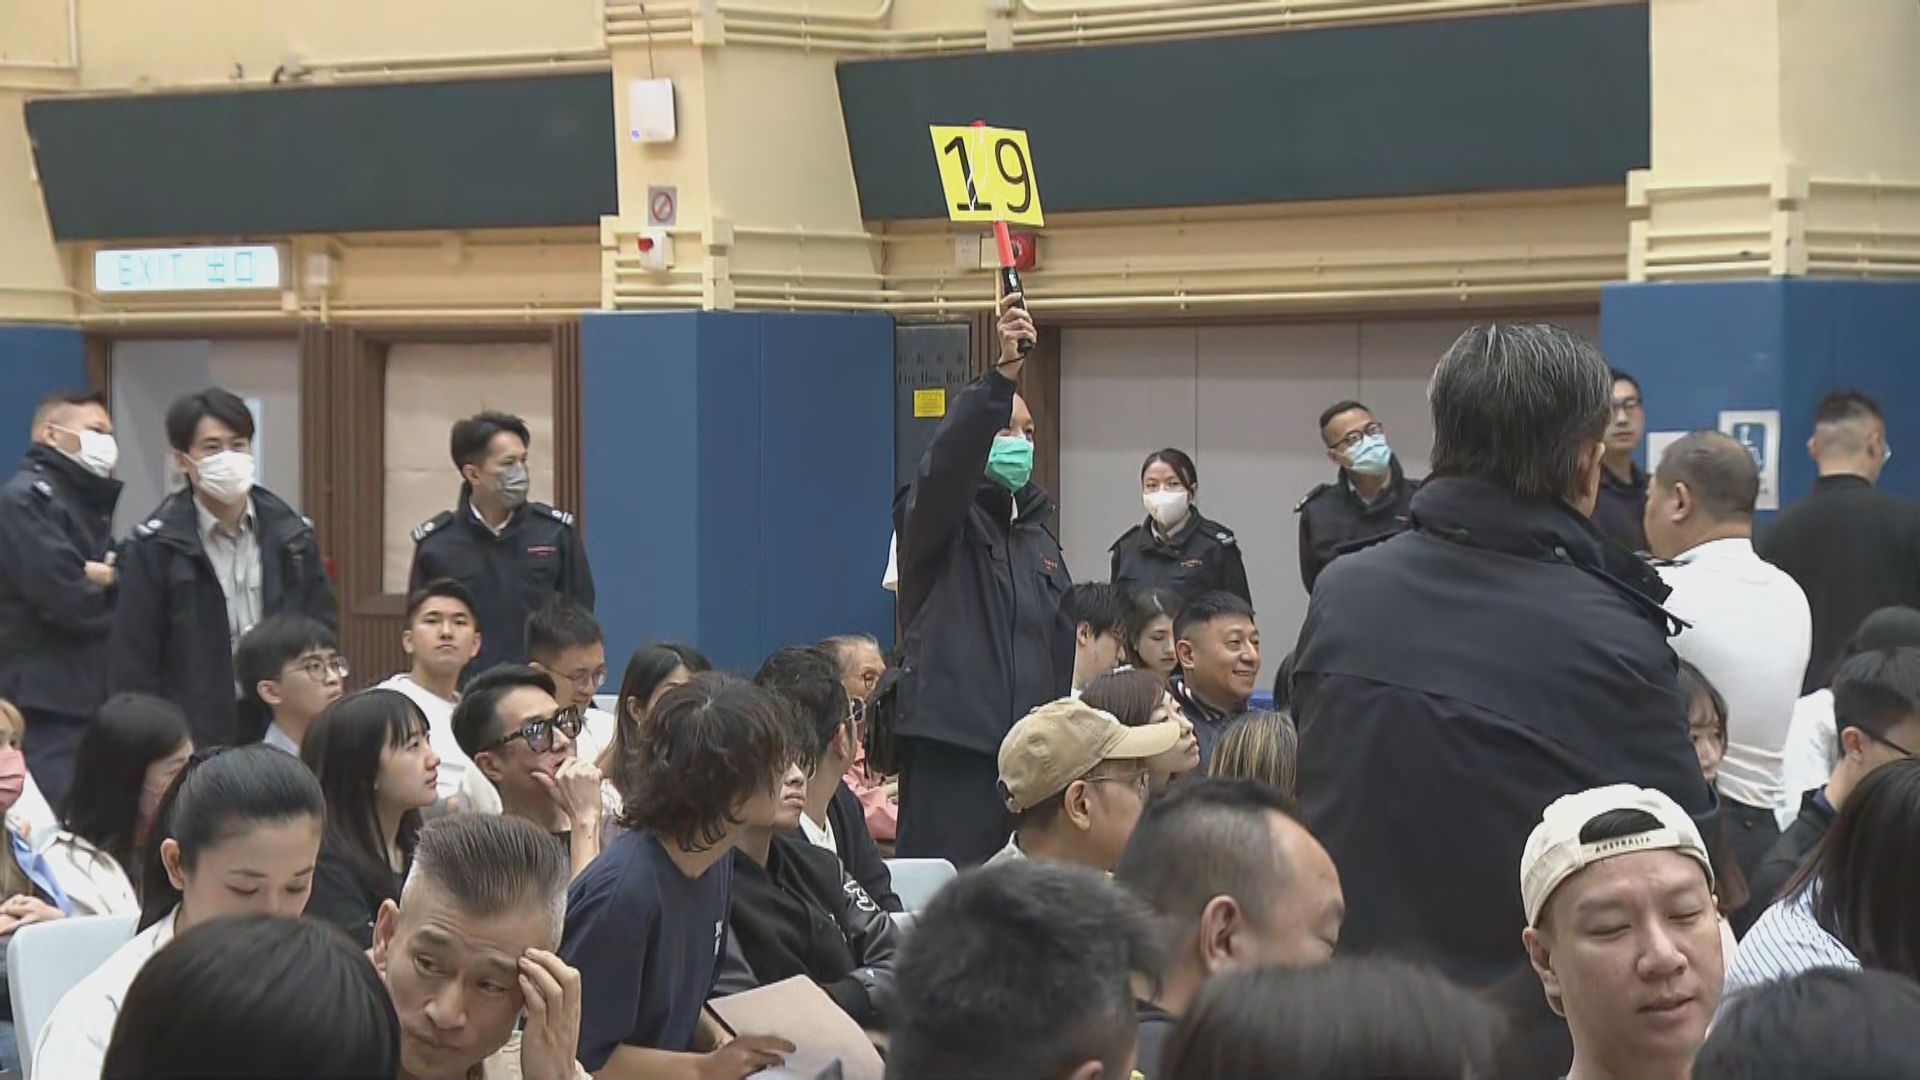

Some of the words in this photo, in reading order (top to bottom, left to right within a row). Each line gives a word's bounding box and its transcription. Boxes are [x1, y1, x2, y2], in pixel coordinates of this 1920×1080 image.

[944, 136, 1031, 213] 19
[119, 253, 183, 285] EXIT
[207, 251, 253, 283] 出口
[1594, 836, 1651, 854] AUSTRALIA
